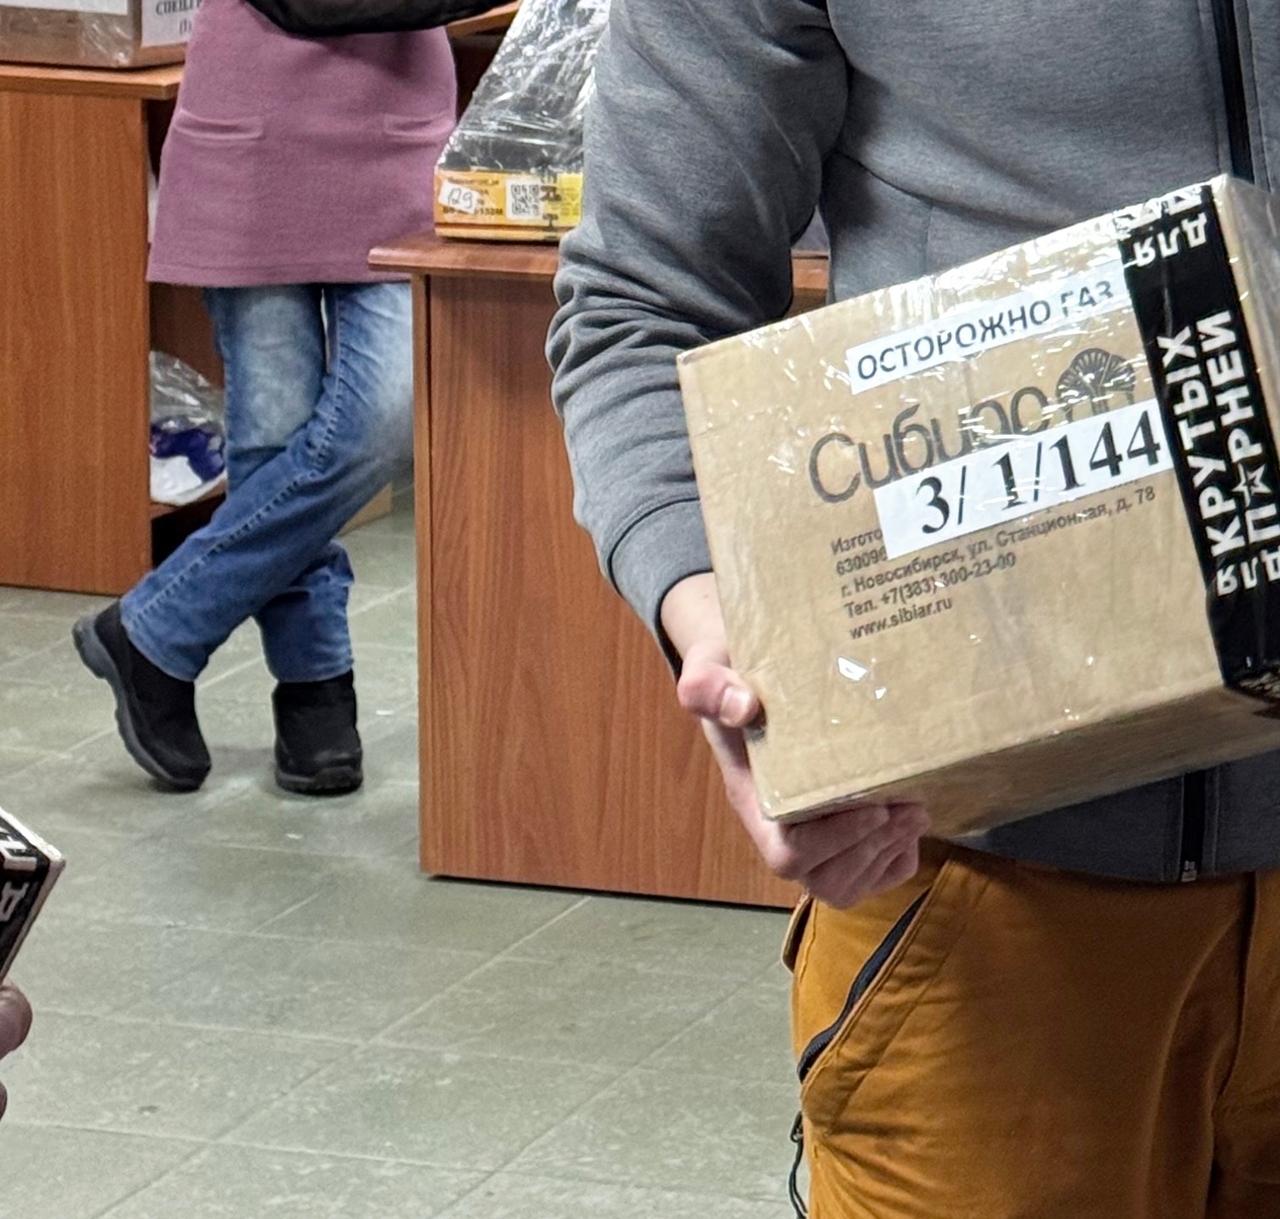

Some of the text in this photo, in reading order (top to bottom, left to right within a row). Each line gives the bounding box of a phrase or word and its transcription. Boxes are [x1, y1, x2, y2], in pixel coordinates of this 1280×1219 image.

[857, 298, 1051, 381] ОСТОРОЖНО
[993, 409, 1162, 510] 1/144
[1157, 325, 1245, 560] КРУТЫХ
[853, 548, 965, 593] Новосибирск,
[967, 538, 993, 561] ул.
[995, 504, 1112, 548] Станционная,
[1135, 485, 1156, 505] 78
[843, 599, 878, 619] Тел.
[850, 597, 953, 640] www.sibiar.ru
